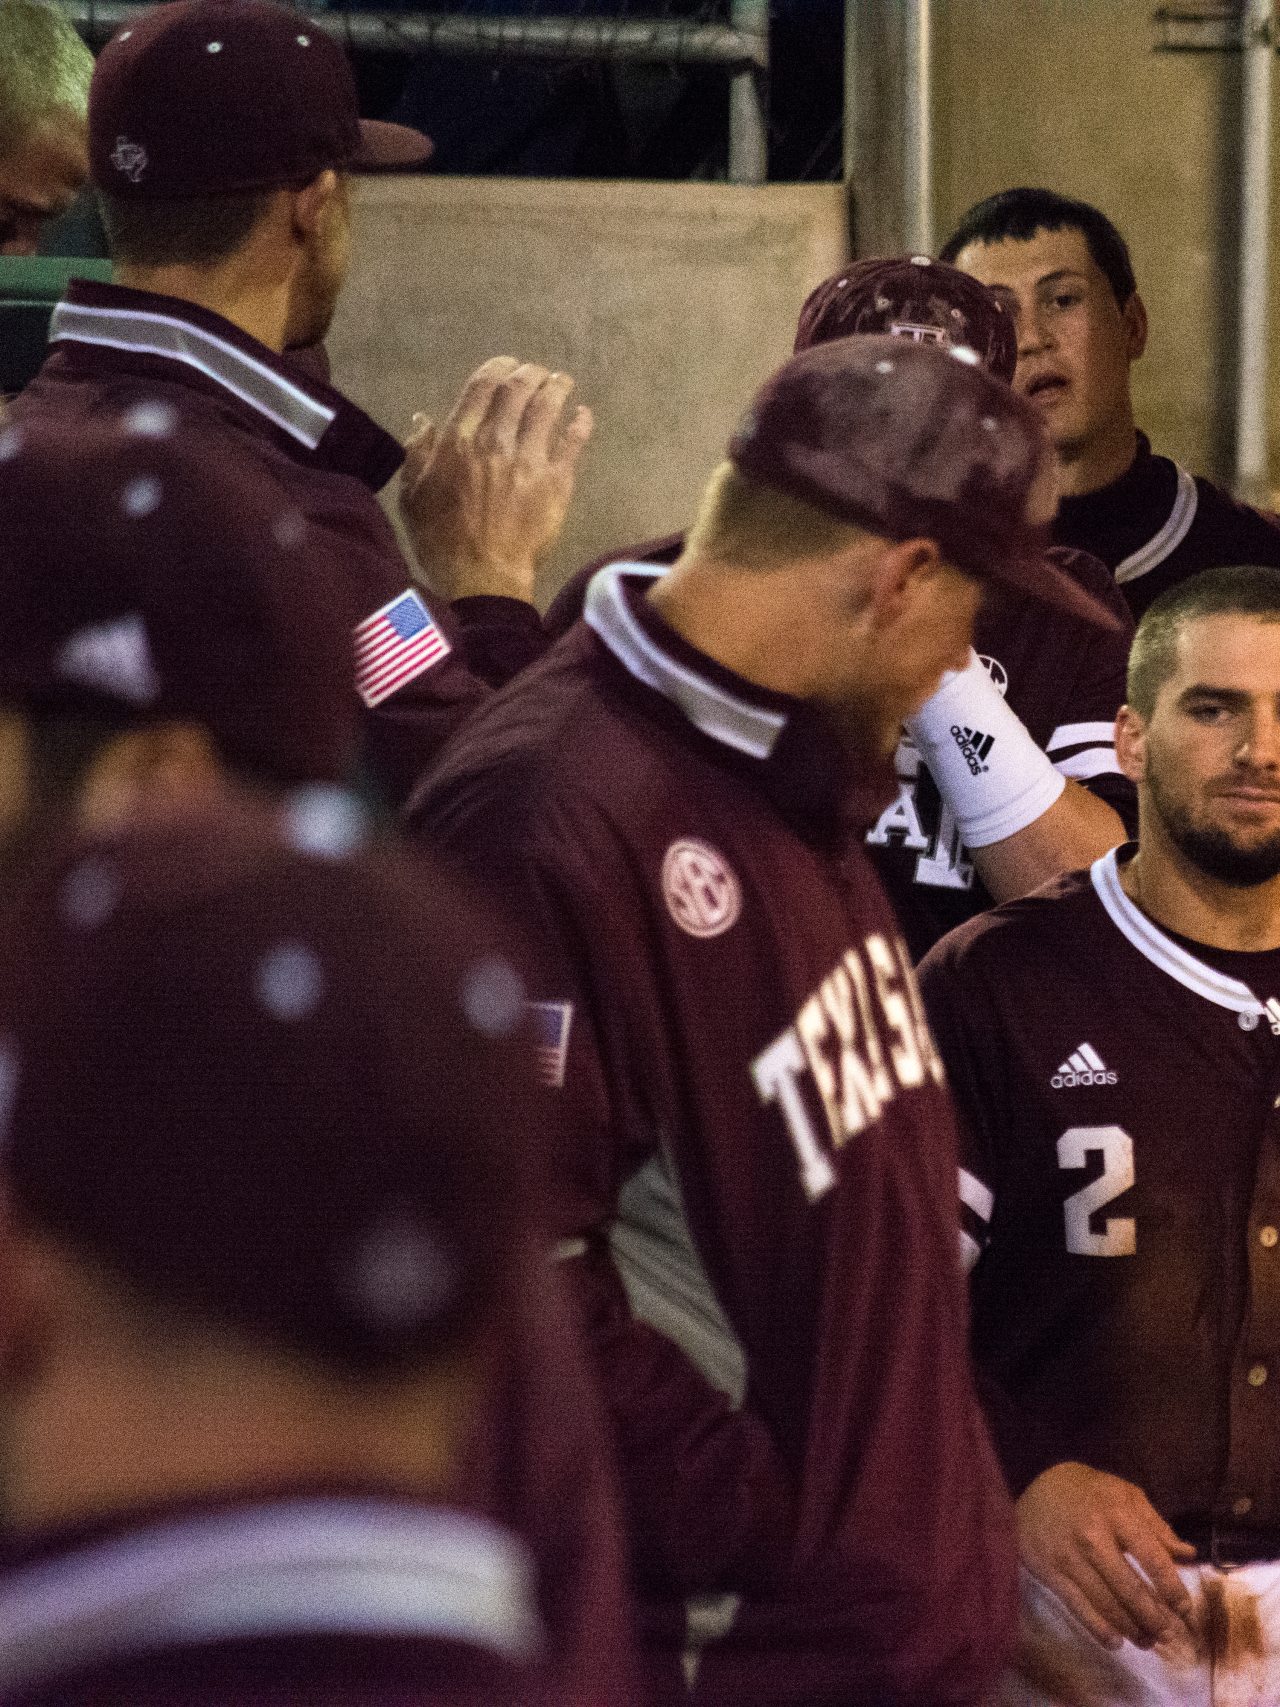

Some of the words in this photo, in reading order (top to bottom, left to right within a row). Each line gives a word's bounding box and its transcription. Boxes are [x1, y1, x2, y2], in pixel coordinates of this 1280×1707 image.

[949, 724, 983, 777] adidas
[1051, 1070, 1119, 1089] adidas
[1056, 1125, 1138, 1258] 2
